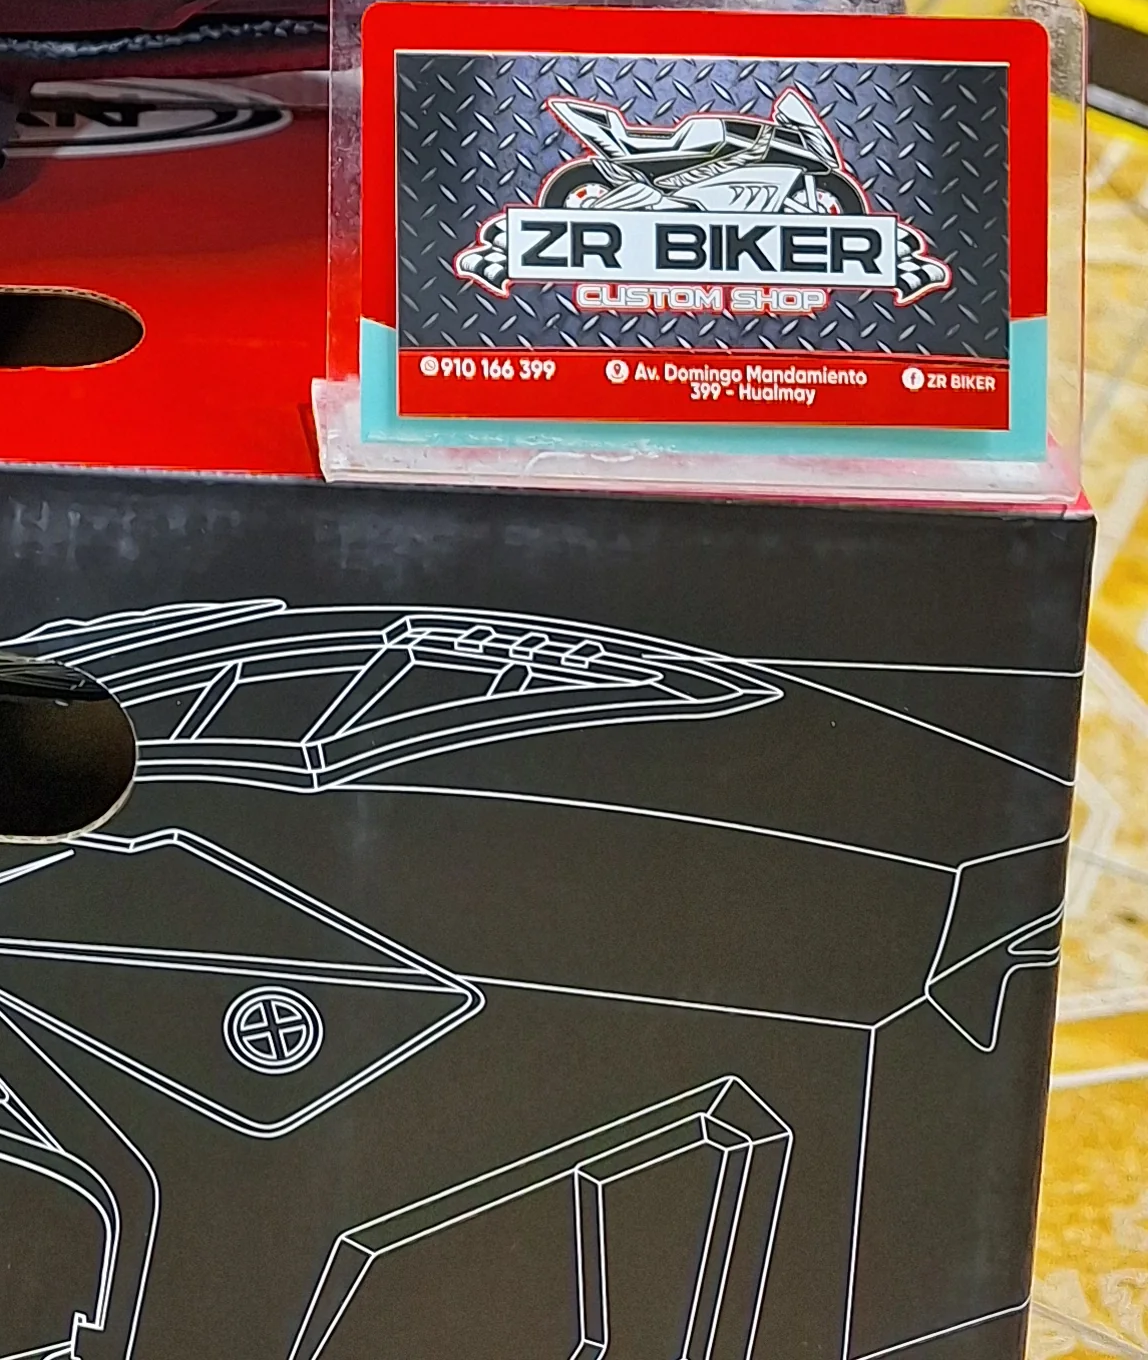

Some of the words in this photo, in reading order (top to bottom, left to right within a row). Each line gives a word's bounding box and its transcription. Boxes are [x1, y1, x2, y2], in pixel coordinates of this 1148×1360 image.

[521, 220, 623, 269] ZR
[654, 222, 882, 275] BIKER
[576, 283, 722, 311] CUSTOM
[730, 286, 828, 312] SHOP
[440, 356, 476, 377] 910
[481, 357, 515, 379] 166
[519, 358, 556, 380] 399
[634, 361, 660, 381] Av.
[664, 363, 742, 386] Domingo
[746, 364, 868, 386] Mandamiento
[690, 382, 721, 400] 399
[739, 384, 816, 406] Hualmay
[927, 375, 947, 389] ZR
[951, 375, 996, 391] BIKER
